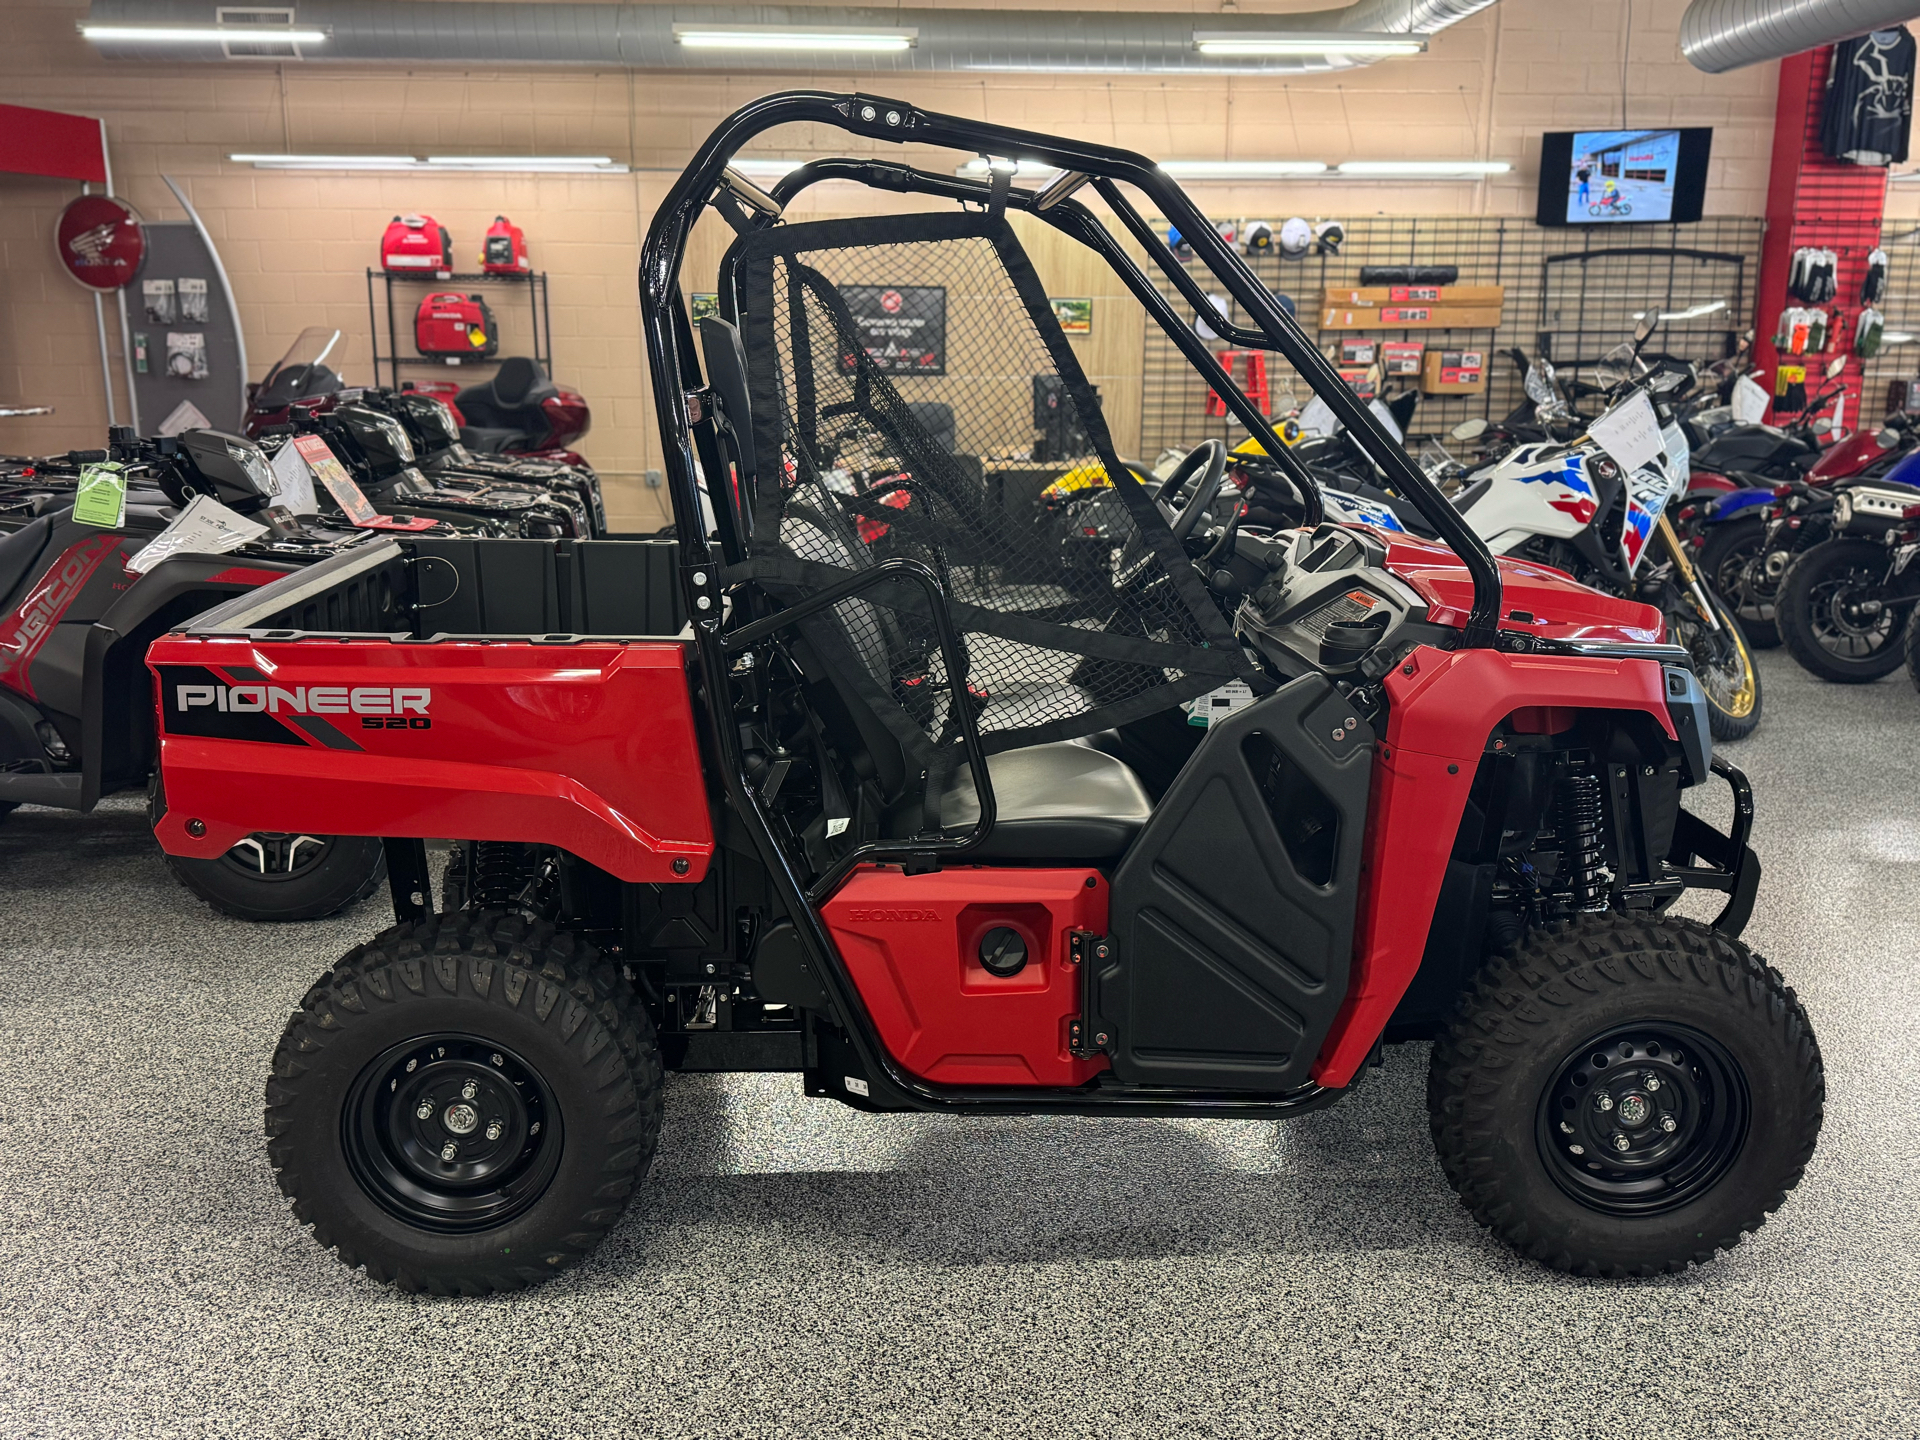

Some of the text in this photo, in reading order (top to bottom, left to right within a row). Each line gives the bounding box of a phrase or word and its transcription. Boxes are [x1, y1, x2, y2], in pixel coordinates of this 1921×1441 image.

[176, 685, 432, 715] PIONEER
[361, 717, 432, 730] 520
[849, 908, 943, 922] HONDA
